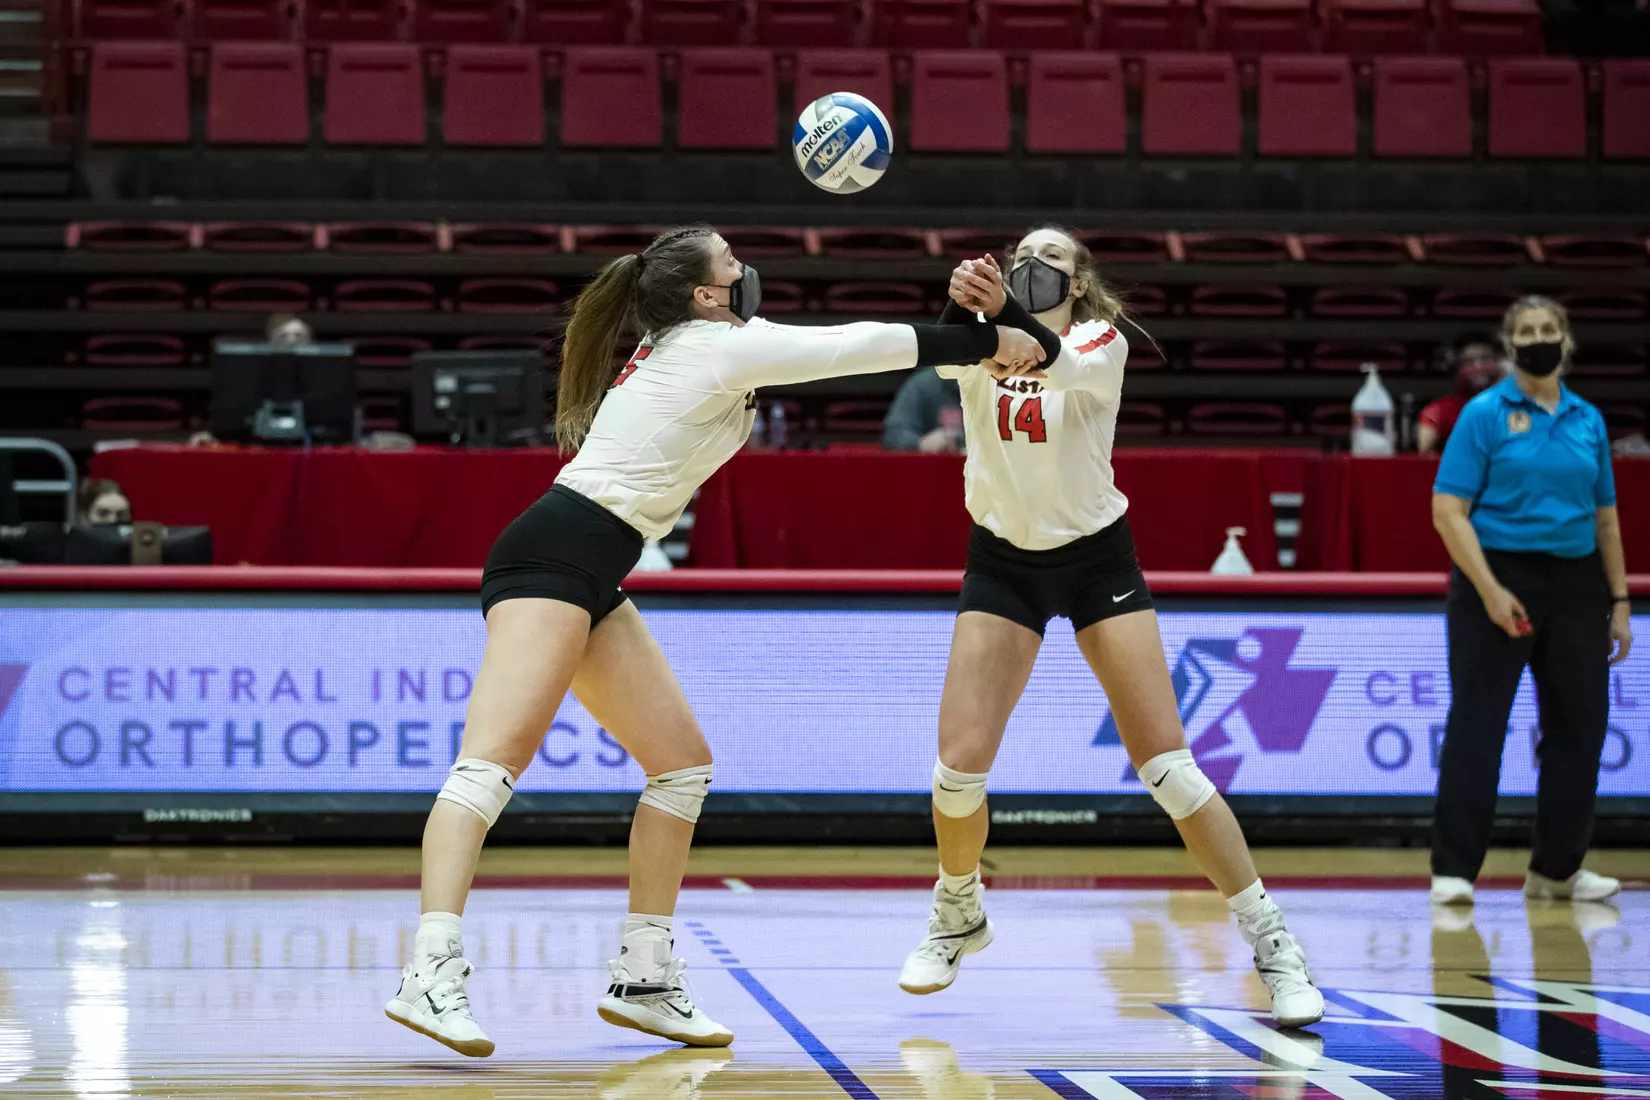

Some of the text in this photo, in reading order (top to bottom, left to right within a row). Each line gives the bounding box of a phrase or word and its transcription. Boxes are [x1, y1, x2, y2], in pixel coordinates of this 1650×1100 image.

[801, 113, 843, 158] molten
[813, 130, 852, 171] NCAA
[998, 394, 1047, 443] 14
[57, 667, 339, 703] CENTRAL
[54, 720, 628, 768] ORTHOPECS
